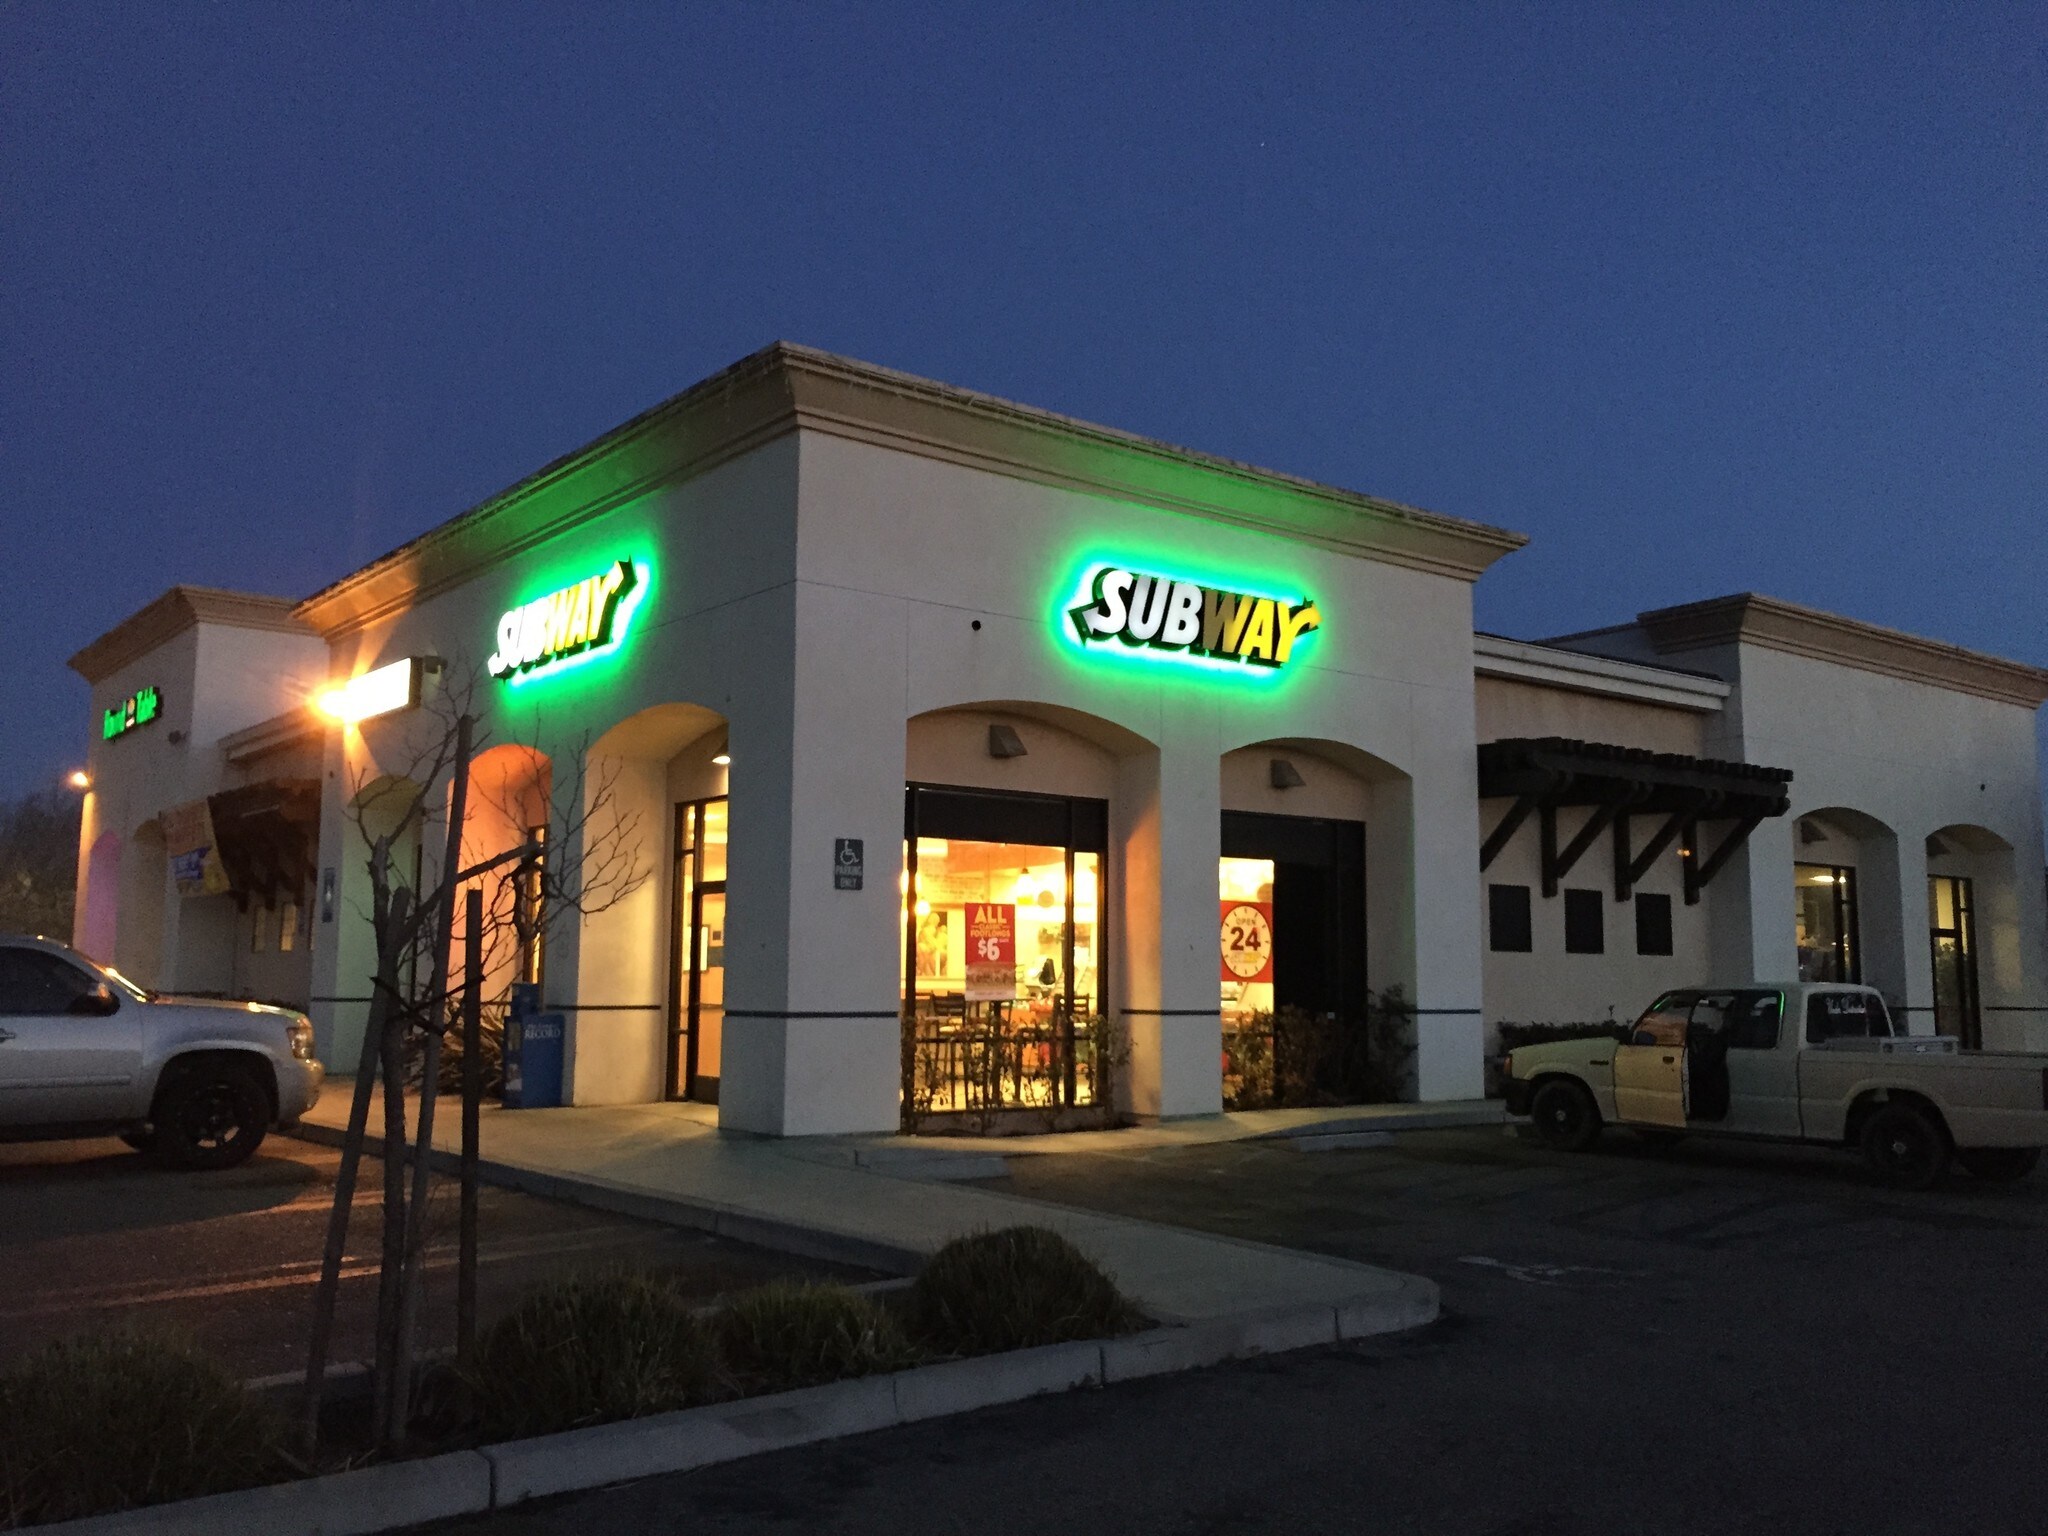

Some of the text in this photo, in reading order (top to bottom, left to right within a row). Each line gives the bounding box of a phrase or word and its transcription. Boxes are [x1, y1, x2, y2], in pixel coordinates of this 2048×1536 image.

[487, 560, 624, 677] SUBWAY
[1082, 569, 1322, 663] SUBWAY
[974, 905, 1007, 924] ALL
[978, 937, 1000, 961] $6
[1230, 926, 1261, 951] 24
[524, 1028, 561, 1040] RECORD
